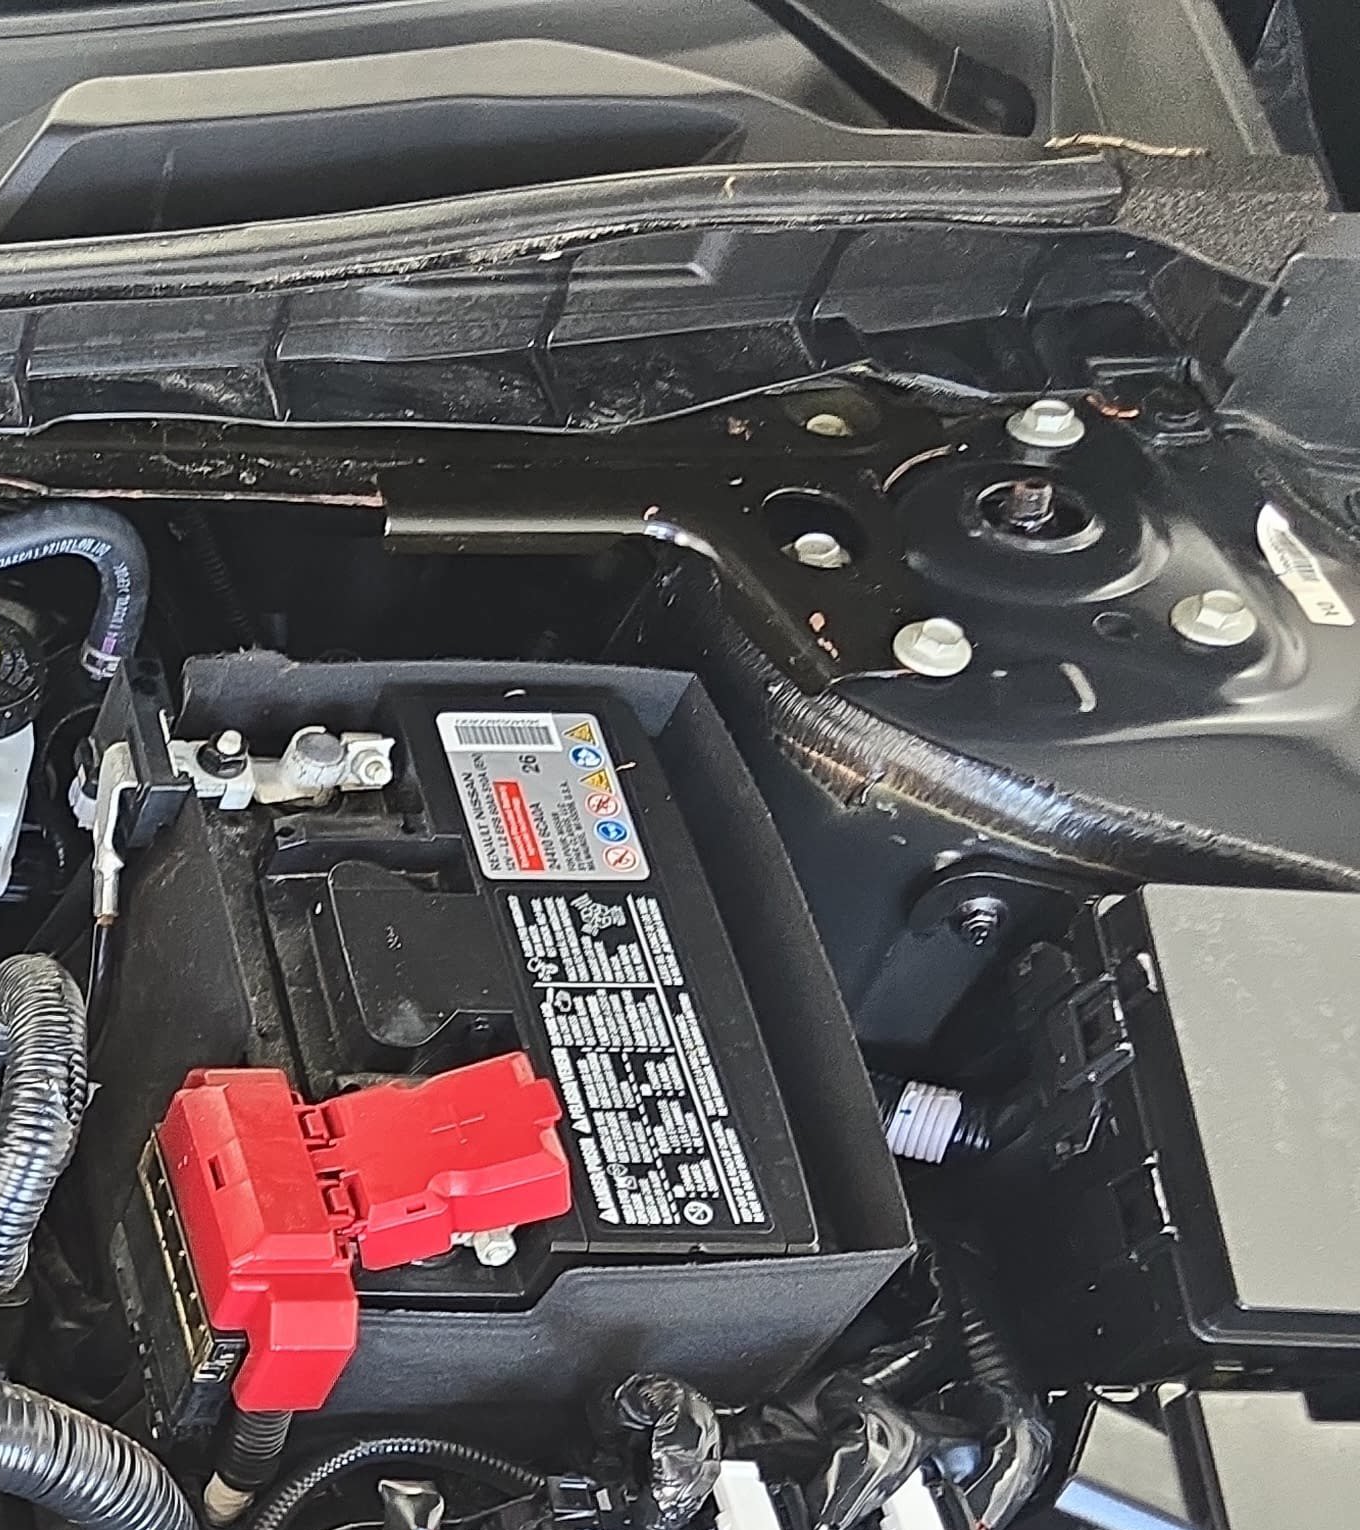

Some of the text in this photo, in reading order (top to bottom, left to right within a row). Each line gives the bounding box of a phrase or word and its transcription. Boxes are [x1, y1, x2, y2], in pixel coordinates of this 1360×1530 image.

[517, 755, 540, 773] 26
[461, 771, 502, 872] RENAULT NISSAN
